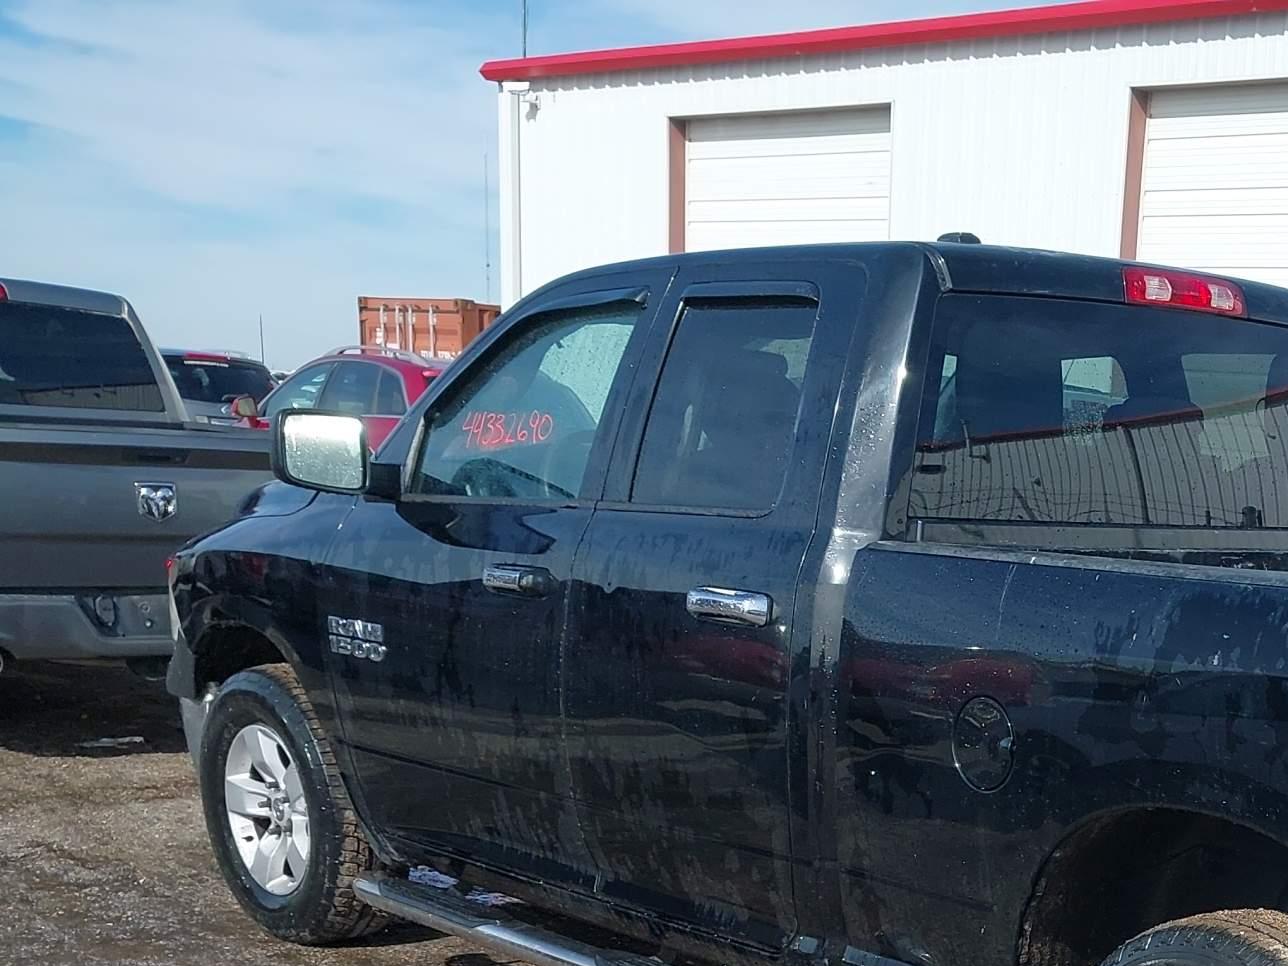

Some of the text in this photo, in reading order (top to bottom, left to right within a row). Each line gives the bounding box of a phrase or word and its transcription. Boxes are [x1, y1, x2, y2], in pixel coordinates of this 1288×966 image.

[462, 409, 553, 449] 44332690
[328, 615, 384, 642] RAM
[329, 635, 386, 662] 1500
